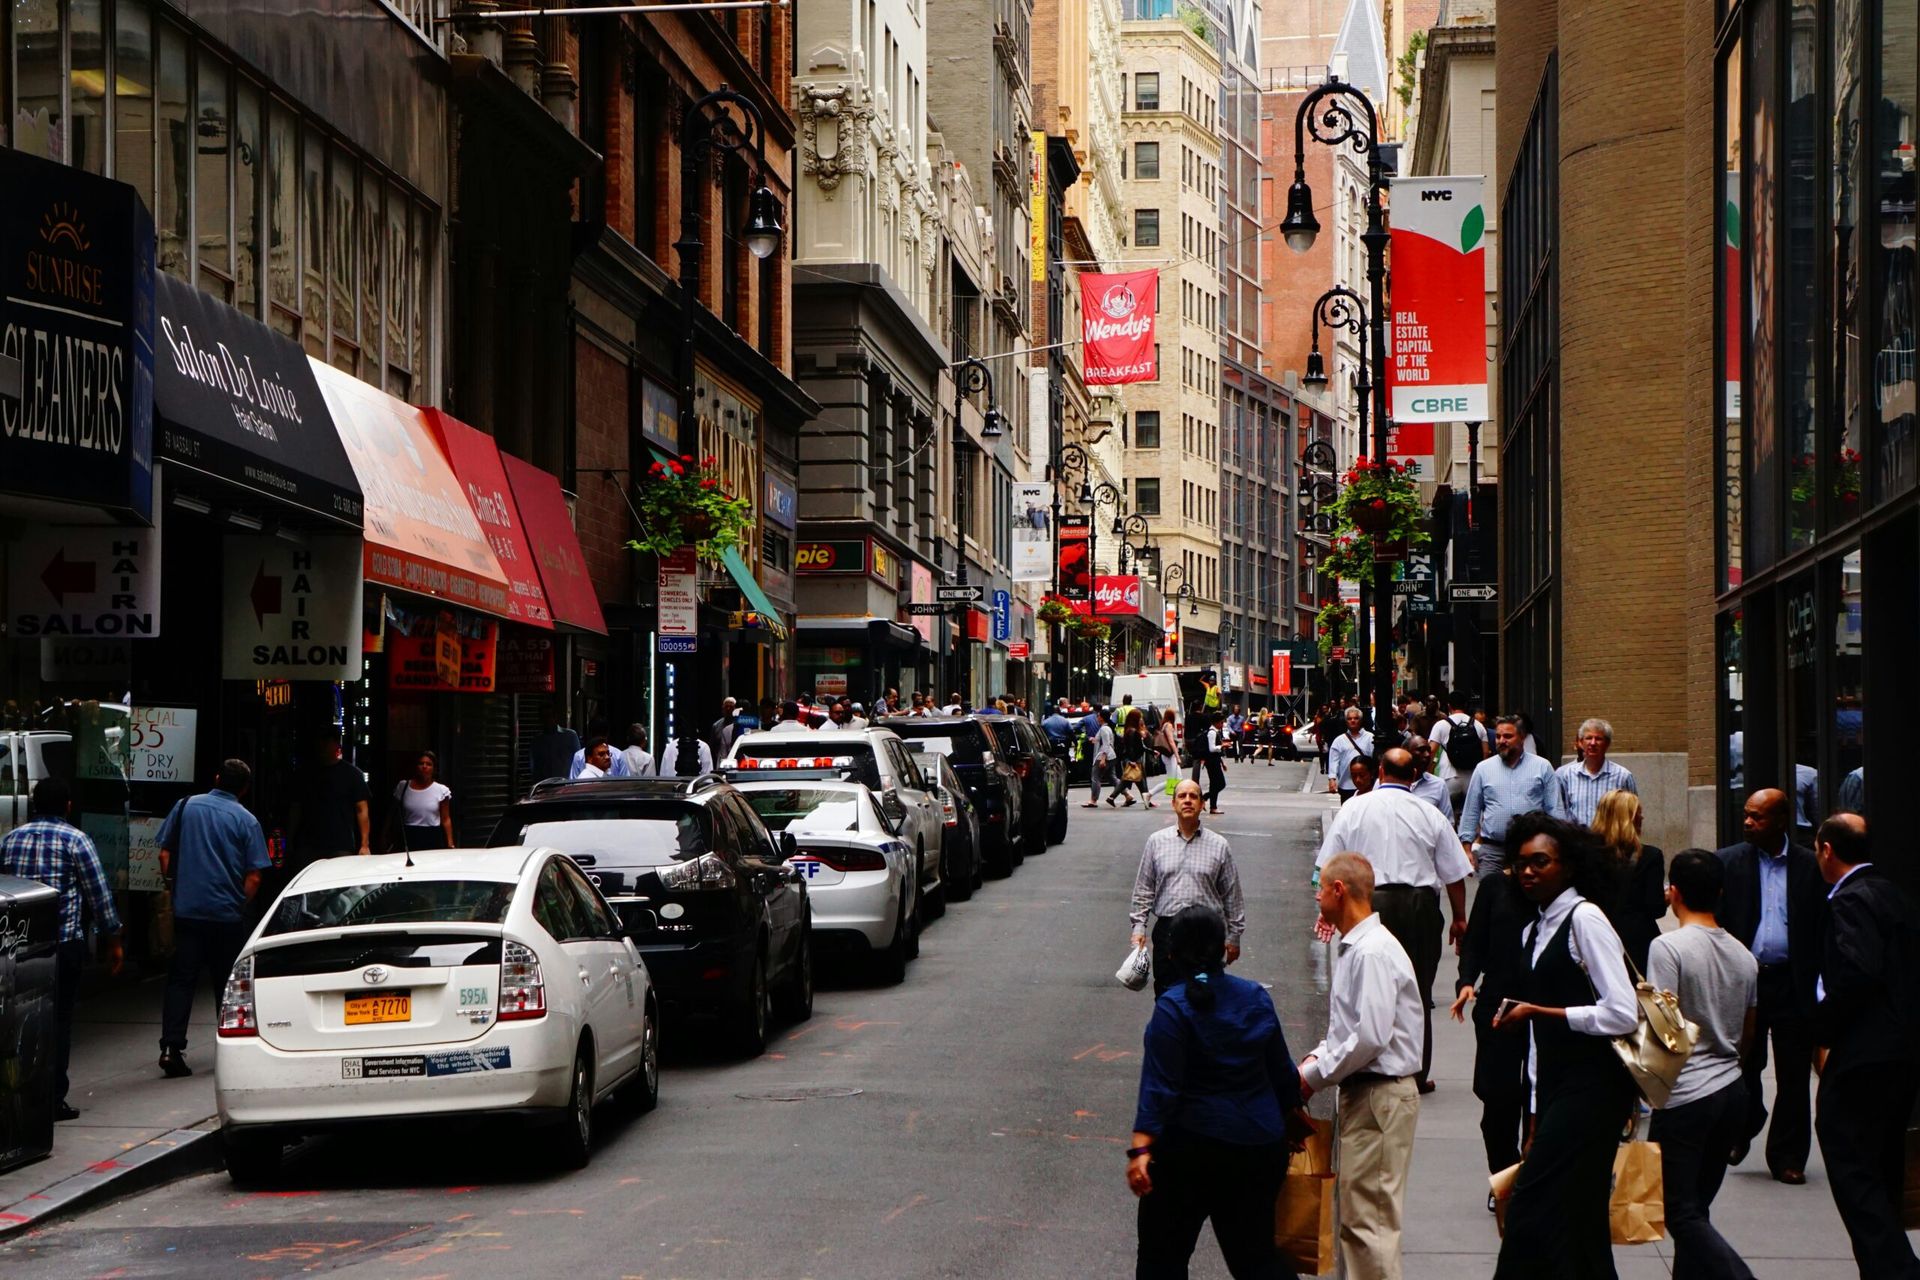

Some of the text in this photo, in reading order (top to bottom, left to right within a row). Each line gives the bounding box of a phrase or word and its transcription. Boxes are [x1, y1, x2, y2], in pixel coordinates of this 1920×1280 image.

[1422, 191, 1452, 201] NYC
[26, 250, 102, 305] SUNRISE
[1396, 312, 1418, 324] REAL
[1085, 313, 1150, 343] Wendy's
[1396, 326, 1428, 338] ESTATE
[1396, 340, 1433, 352] CAPITAL
[1397, 354, 1427, 367] OF THE
[161, 316, 302, 425] Salon De Louie
[1086, 362, 1152, 379] BREAKFAST
[1397, 368, 1430, 382] WORLD
[2, 322, 123, 455] CLEANERS
[1411, 398, 1468, 413] CBRE
[231, 403, 278, 442] Hair Salon
[468, 482, 499, 526] China
[494, 491, 511, 528] 59
[795, 544, 829, 569] pie
[112, 541, 139, 609] HAIR
[292, 551, 311, 640] HAIR
[1394, 584, 1417, 593] JOHN
[16, 613, 153, 634] SALON
[996, 592, 1006, 639] DINER
[661, 642, 688, 650] 100055
[253, 645, 347, 665] SALON
[147, 753, 174, 769] DRY
[460, 988, 488, 1006] 595A
[381, 998, 408, 1016] 7270
[344, 1060, 361, 1068] DIAL
[365, 1057, 424, 1066] Government Information
[431, 1056, 449, 1064] Your
[409, 1066, 421, 1074] NYC
